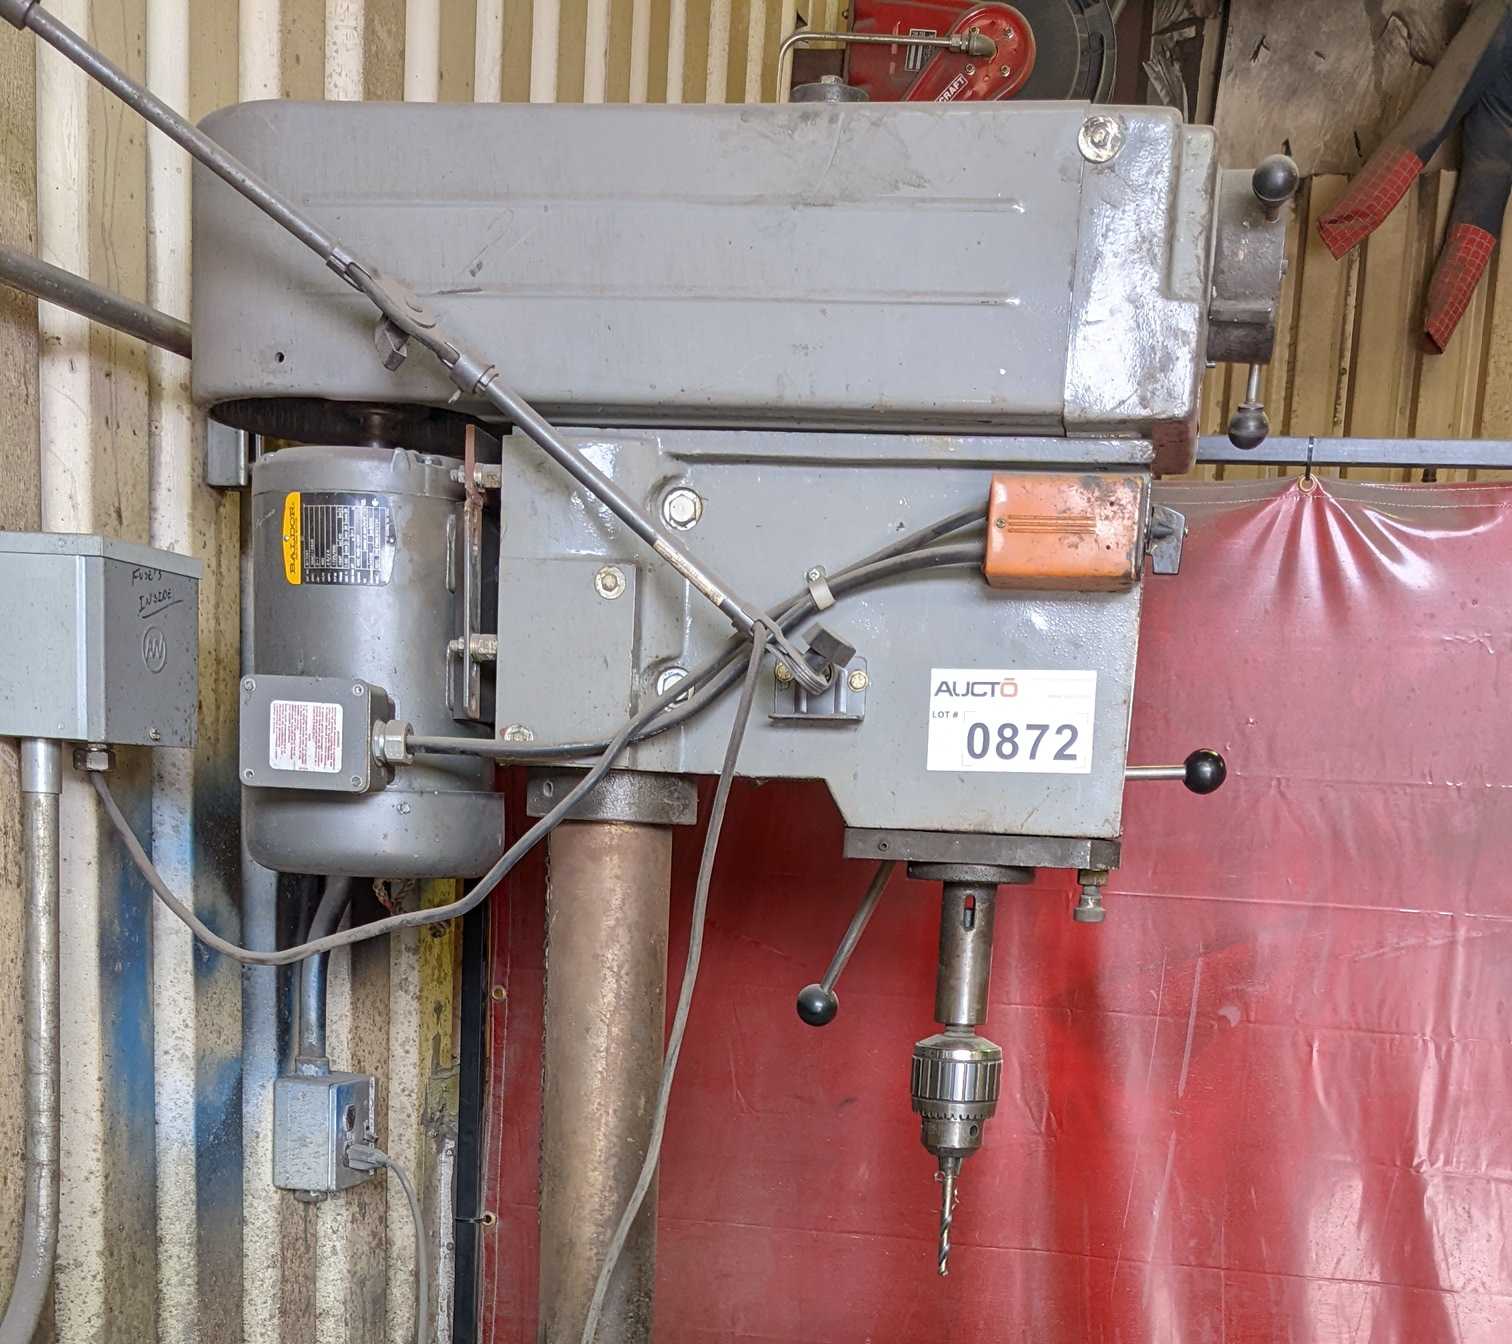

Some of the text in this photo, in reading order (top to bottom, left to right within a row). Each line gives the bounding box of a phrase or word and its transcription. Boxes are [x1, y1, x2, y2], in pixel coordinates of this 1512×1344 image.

[289, 507, 297, 575] BALDOR
[932, 711, 959, 719] LOT #
[967, 722, 1079, 761] 0872
